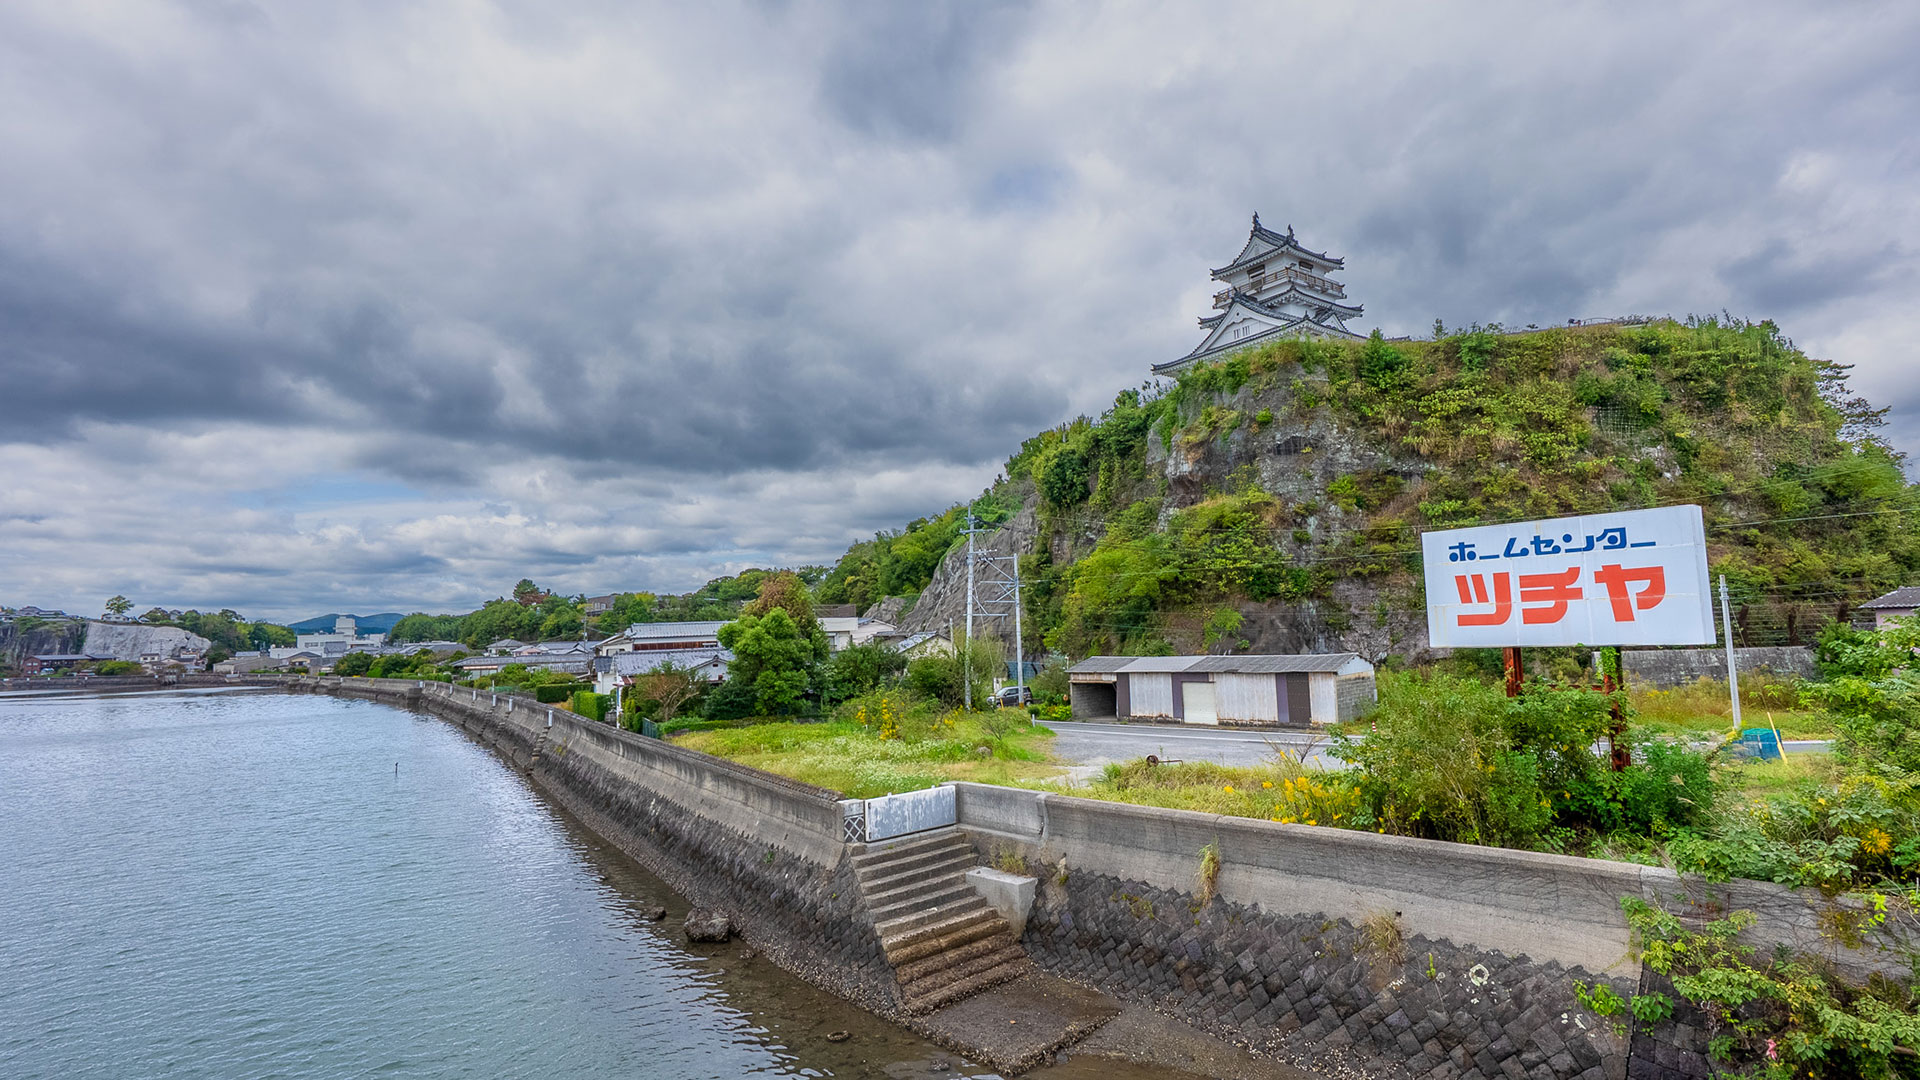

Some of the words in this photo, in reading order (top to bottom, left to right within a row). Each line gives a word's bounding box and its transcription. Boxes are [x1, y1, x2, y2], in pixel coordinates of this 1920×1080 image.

[1448, 527, 1656, 562] ホームセンター
[1455, 564, 1666, 626] ツチヤ
